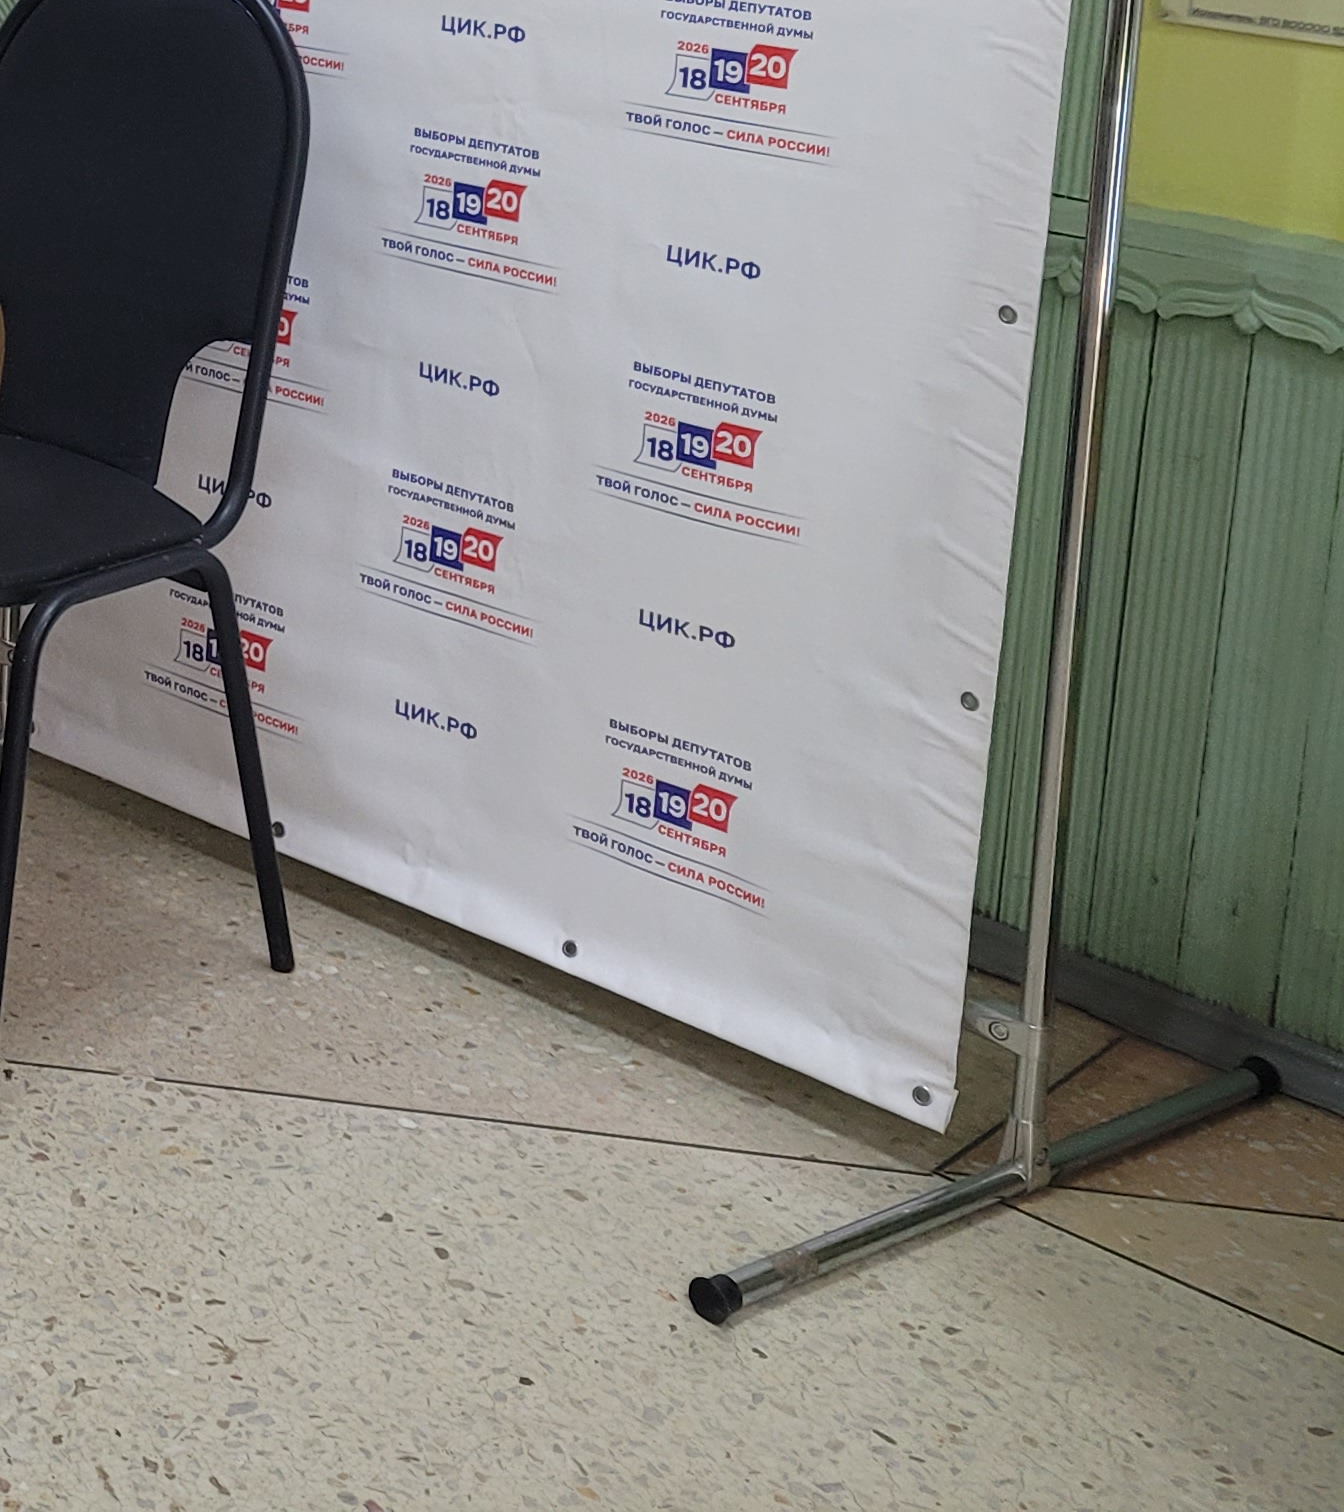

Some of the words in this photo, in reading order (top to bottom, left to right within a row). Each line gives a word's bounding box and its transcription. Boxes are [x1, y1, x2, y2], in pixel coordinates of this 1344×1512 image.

[660, 9, 775, 35] ГОСУДАРСТВЕННОЙ
[775, 26, 814, 40] ДУМЫ
[727, 0, 812, 21] ДЕПУТАТОВ
[441, 14, 526, 44] ЦИК.РФ
[677, 40, 709, 55] 2026
[678, 66, 707, 91] 18
[713, 59, 745, 85] 19
[749, 53, 787, 79] 20
[714, 93, 787, 115] СЕНТЯБРЯ
[413, 127, 466, 146] ВЫБОРЫ
[467, 137, 540, 160] ДЕПУТАТОВ
[625, 111, 663, 128] ТВОЙ
[665, 118, 711, 136] ГОЛОС
[726, 129, 764, 146] СИЛА
[767, 136, 831, 157] РОССИИ!
[409, 144, 507, 171] ГОСУДАРСТВЕННОЙ
[508, 164, 541, 177] ДУМЫ
[423, 173, 452, 187] 2026
[425, 197, 451, 221] 18
[456, 192, 485, 215] 19
[486, 187, 518, 213] 20
[456, 223, 519, 246] СЕНТЯБРЯ
[381, 237, 413, 254] ТВОЙ
[415, 245, 454, 263] ГОЛОС
[467, 257, 501, 273] СИЛА
[503, 265, 558, 287] РОССИИ!
[666, 244, 761, 280] ЦИК.РФ
[419, 361, 500, 397] ЦИК.РФ
[633, 360, 692, 385] ВЫБОРЫ
[693, 376, 776, 405] ДЕПУТАТОВ
[628, 379, 739, 415] ГОСУДАРСТВЕННОЙ
[740, 407, 778, 423] ДУМЫ
[644, 411, 676, 427] 2026
[646, 437, 674, 462] 18
[681, 433, 715, 461] 19
[715, 431, 752, 458] 20
[681, 466, 753, 493] СЕНТЯБРЯ
[595, 474, 631, 494] ТВОЙ
[634, 485, 679, 507] ГОЛОС
[693, 502, 732, 521] СИЛА
[735, 513, 801, 537] РОССИИ!
[638, 608, 736, 649] ЦИК.РФ
[395, 698, 478, 740] ЦИК.РФ
[609, 718, 669, 745] ВЫБОРЫ
[671, 737, 752, 772] ДЕПУТАТОВ
[605, 735, 717, 778] ГОСУДАРСТВЕННОЙ
[717, 771, 753, 791] ДУМЫ
[621, 767, 654, 785] 2026
[624, 792, 652, 819] 18
[658, 791, 686, 818] 19
[687, 793, 727, 821] 20
[657, 824, 727, 858] СЕНТЯБРЯ
[572, 825, 609, 847] ТВОЙ
[610, 839, 653, 864] ГОЛОС
[667, 861, 706, 884] СИЛА
[708, 875, 766, 909] РОССИИ!
